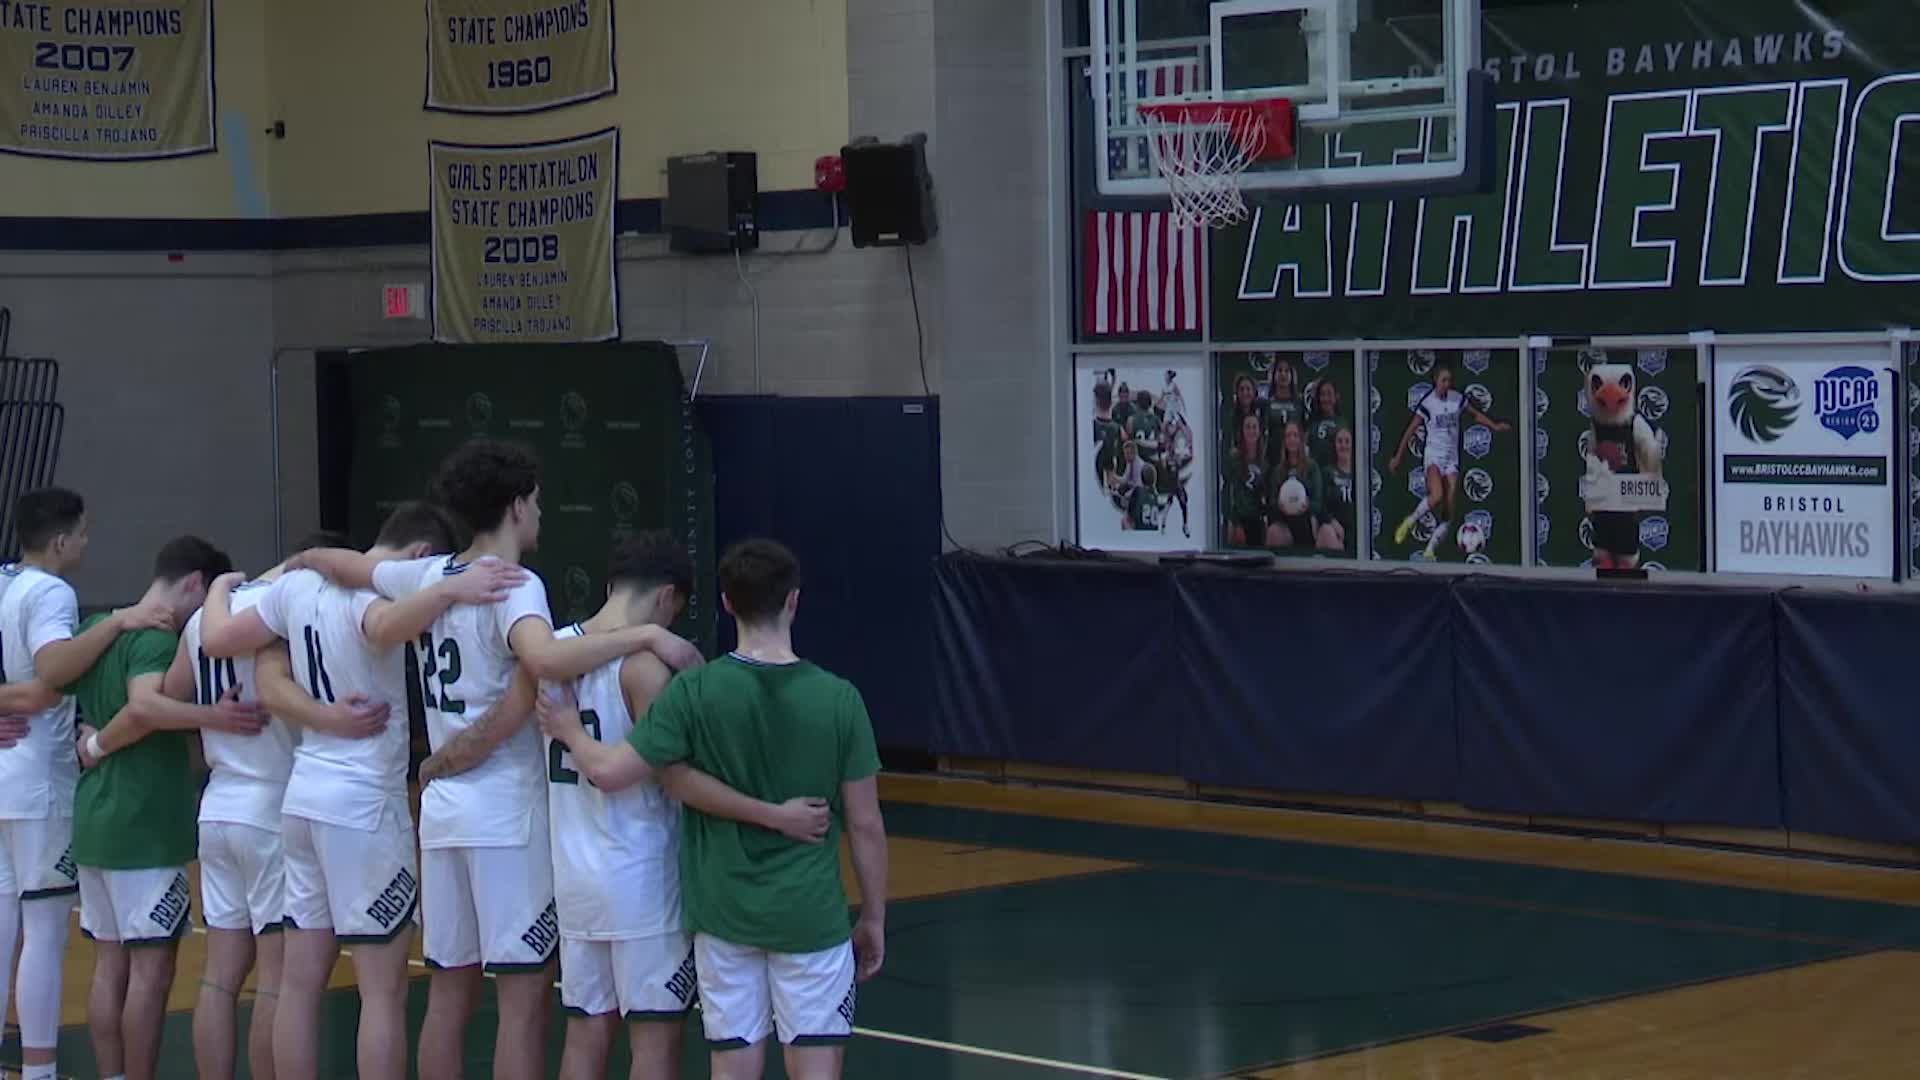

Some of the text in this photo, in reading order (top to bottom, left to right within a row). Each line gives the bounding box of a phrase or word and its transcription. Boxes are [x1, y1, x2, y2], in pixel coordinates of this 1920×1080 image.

[65, 8, 181, 36] CHAMPIONS
[449, 1, 588, 44] STATE CHAMPIONS
[35, 42, 135, 72] 2007
[1607, 31, 1847, 75] BAYHAWKS
[488, 56, 551, 88] 1960
[24, 77, 150, 96] LAUREN BENJAMIN
[32, 103, 143, 119] AMANDA DILLEY
[21, 124, 158, 142] PRISCILLA TROJANO
[448, 151, 598, 191] GIRLS PENTATHLON
[452, 191, 593, 228] STATE CHAMPIONS
[484, 235, 559, 263] 2008
[483, 296, 521, 311] AMANDA
[1814, 380, 1878, 415] NJCAA
[1861, 413, 1877, 428] 21
[1730, 463, 1879, 477] www.BRISTOLCCBAYHAWKS.com
[1621, 481, 1661, 496] BRISTOL
[1763, 496, 1844, 513] BRISTOL
[1740, 520, 1870, 558] BAYHAWKS
[420, 632, 465, 715] 22
